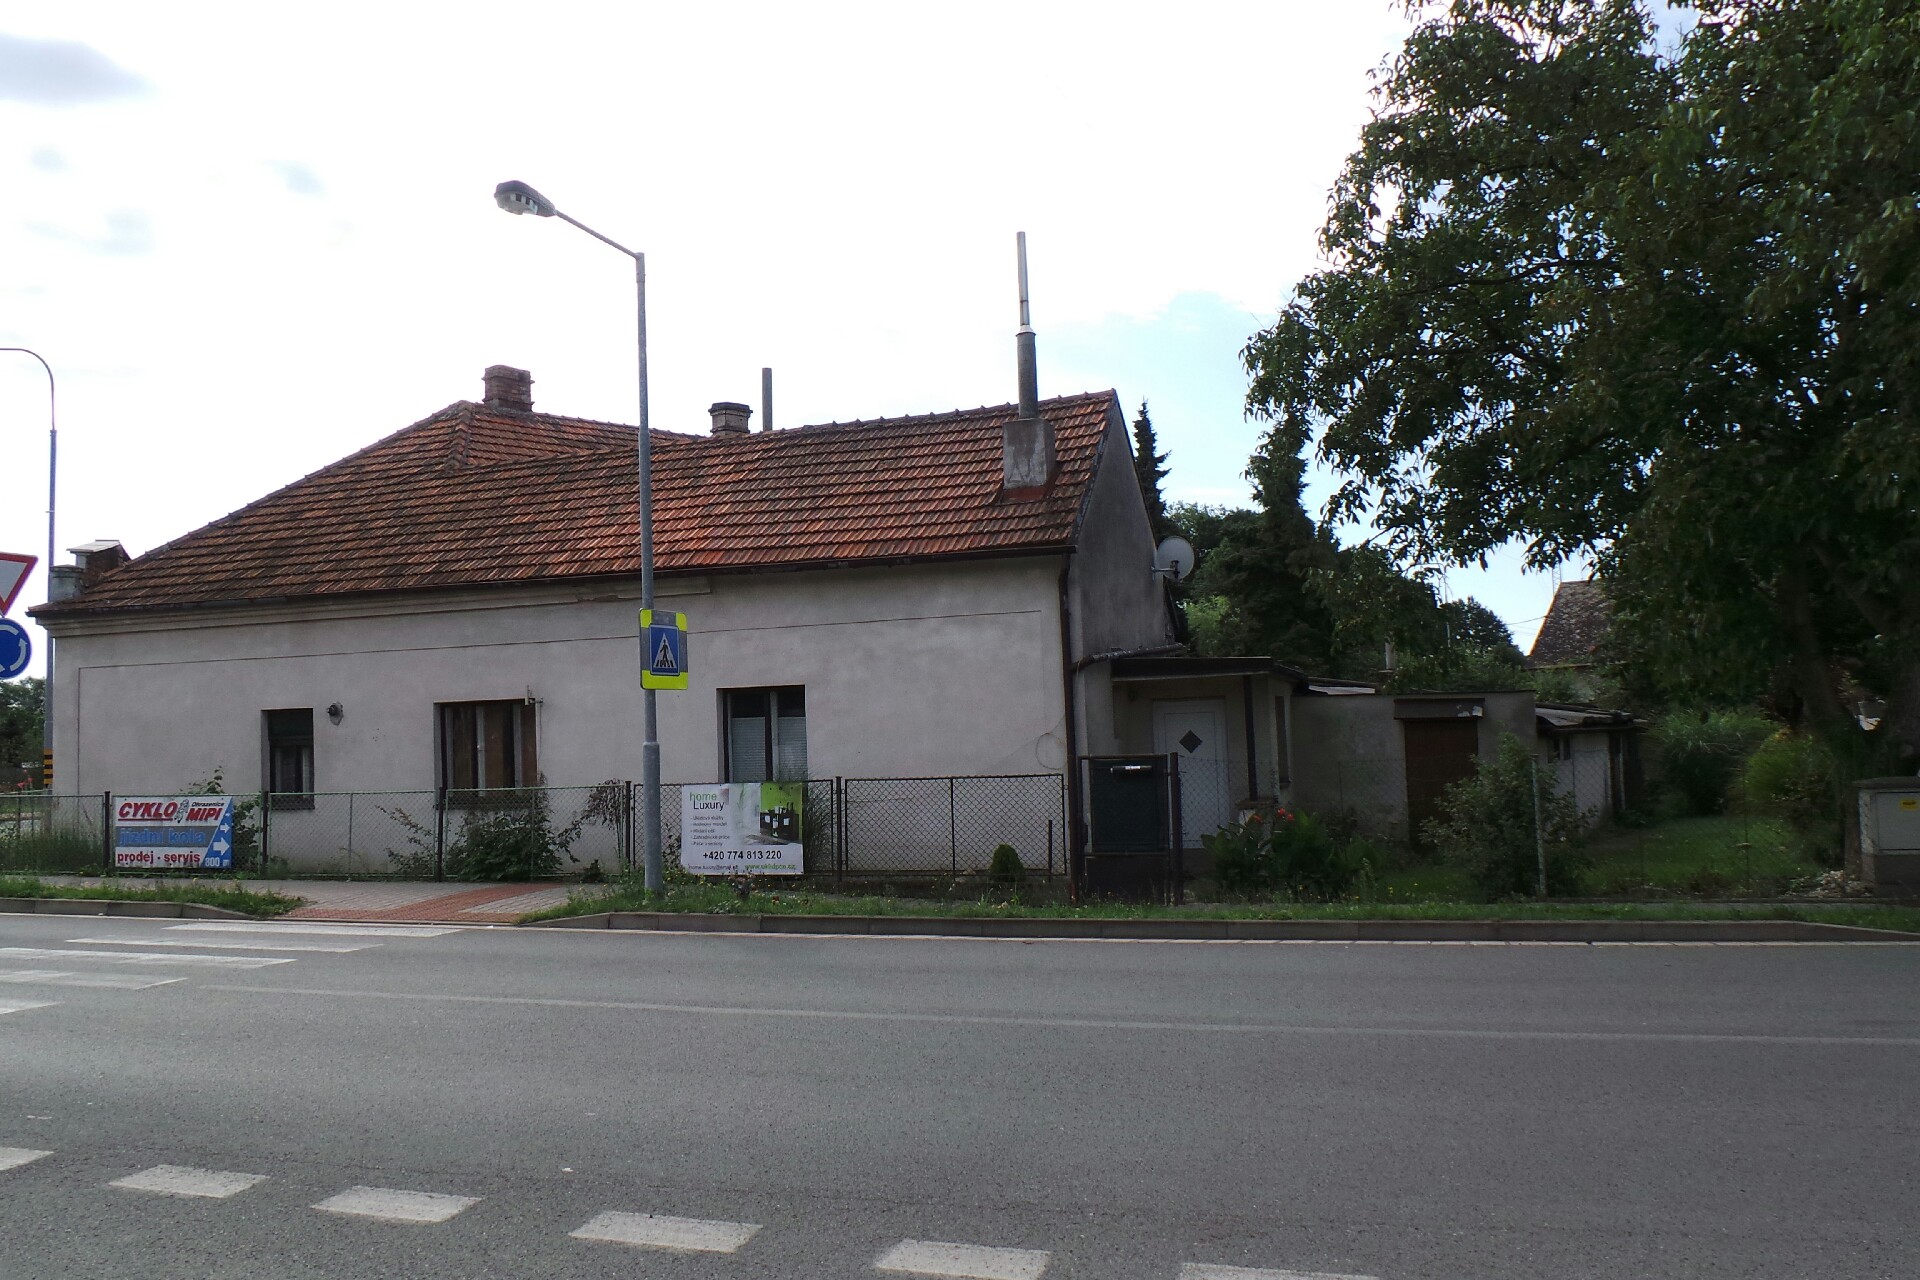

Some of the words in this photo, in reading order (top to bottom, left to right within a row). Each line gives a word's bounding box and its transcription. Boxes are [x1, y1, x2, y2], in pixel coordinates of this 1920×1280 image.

[689, 791, 717, 801] home
[118, 801, 179, 818] CYKLO
[693, 800, 725, 811] Luxury
[185, 807, 223, 821] MIPI
[168, 828, 206, 844] kola
[117, 850, 154, 865] prodej
[163, 850, 201, 863] servis
[703, 850, 725, 860] +420
[727, 850, 744, 860] 774
[746, 850, 764, 860] 813
[765, 850, 782, 860] 220
